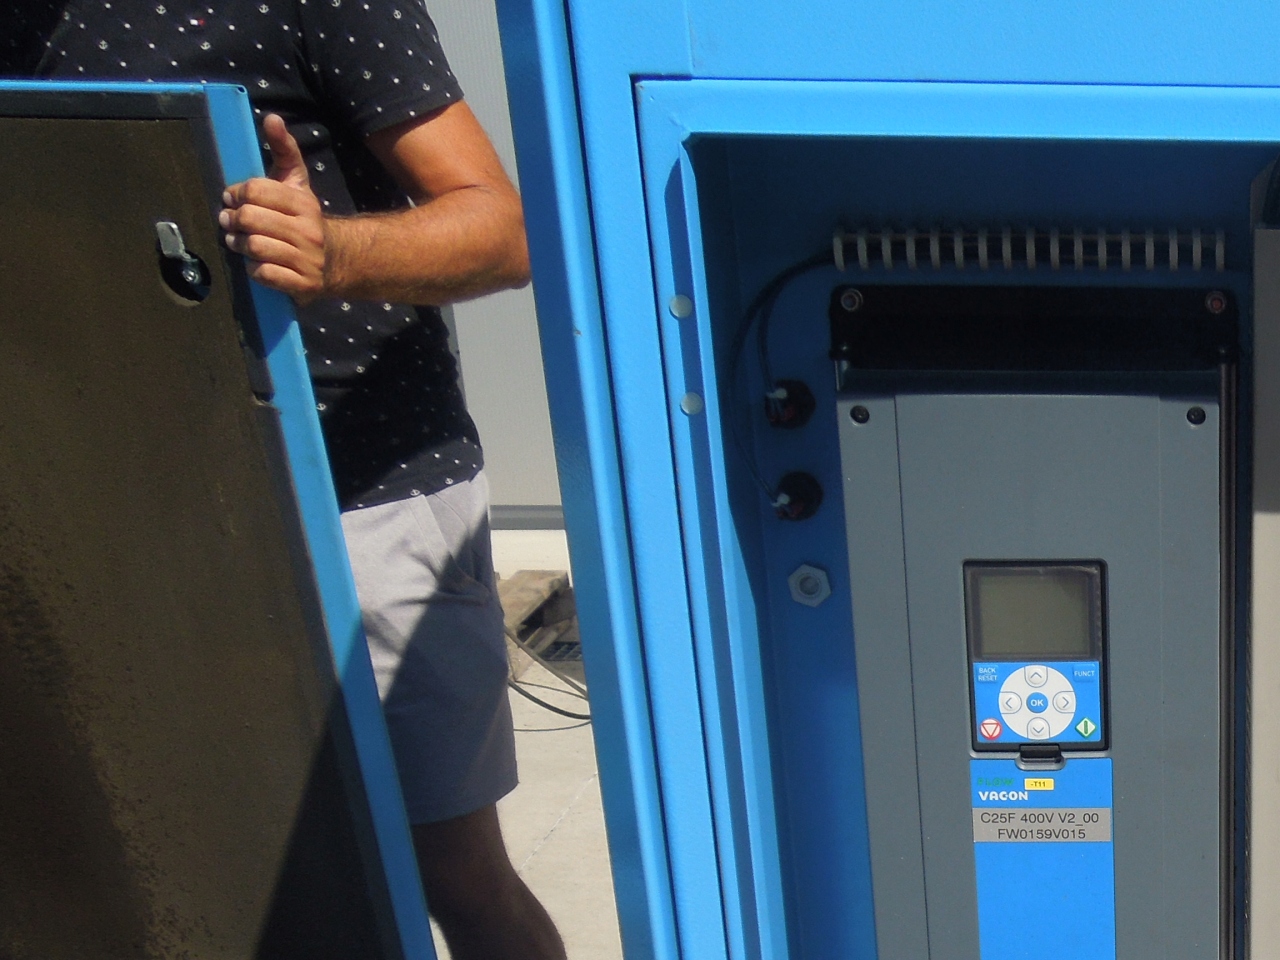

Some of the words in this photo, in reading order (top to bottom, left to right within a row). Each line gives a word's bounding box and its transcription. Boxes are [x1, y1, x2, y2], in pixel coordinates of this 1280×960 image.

[978, 791, 1028, 800] VACON
[980, 812, 1015, 823] C25F
[1020, 813, 1054, 823] 400V
[1058, 813, 1099, 826] V2_00
[998, 829, 1085, 839] FW0159V015
